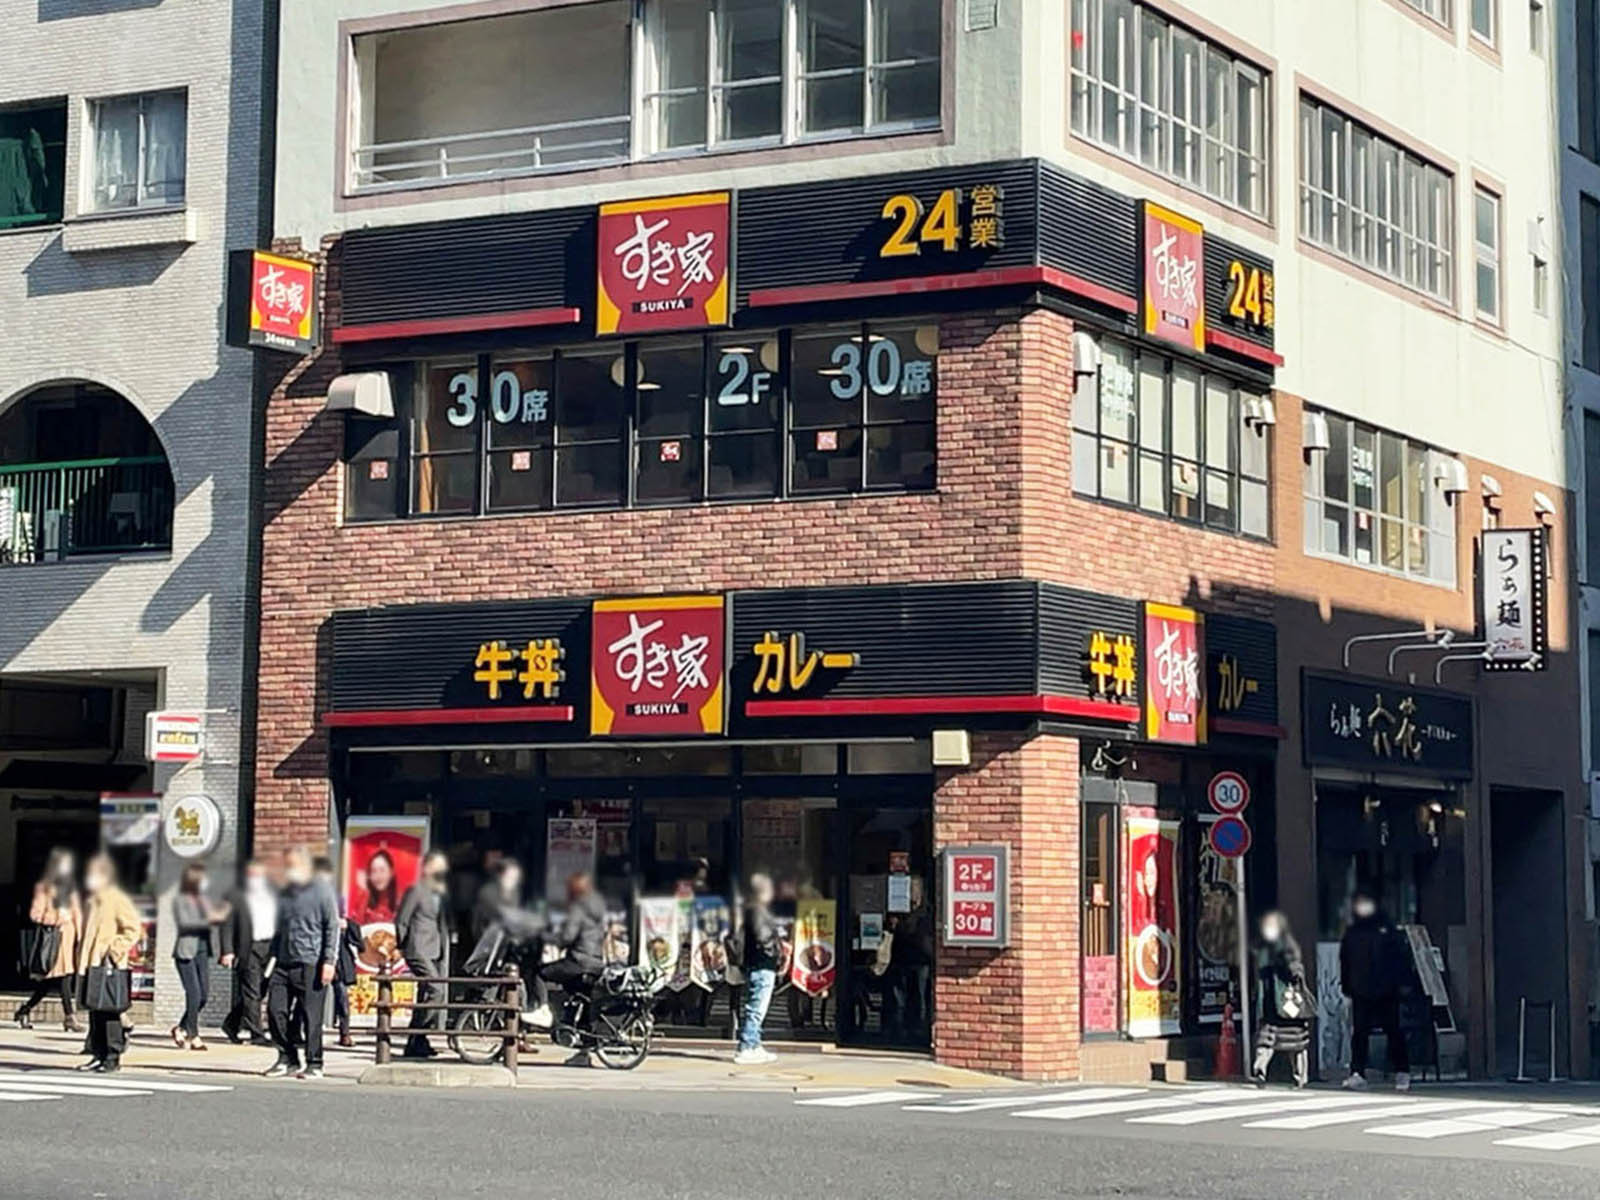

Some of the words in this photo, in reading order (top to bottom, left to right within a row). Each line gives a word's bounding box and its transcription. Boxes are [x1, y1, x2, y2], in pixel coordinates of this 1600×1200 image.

[613, 214, 715, 296] すき家
[880, 189, 962, 258] 24
[258, 264, 305, 316] すき家
[1151, 223, 1198, 309] すき家
[1229, 260, 1262, 325] 24
[639, 298, 686, 313] SUKIYA
[717, 353, 772, 406] 2F
[829, 339, 932, 402] 30席
[1496, 538, 1523, 629] らぁ麺
[474, 639, 567, 700] 牛丼
[607, 613, 710, 700] すき家
[752, 630, 861, 694] カレー
[1089, 630, 1136, 697] 牛丼
[1153, 619, 1201, 709] すき家
[1217, 653, 1259, 711] カレー
[634, 703, 680, 715] SUKIYA
[1218, 784, 1241, 804] 30
[958, 863, 983, 881] 2F
